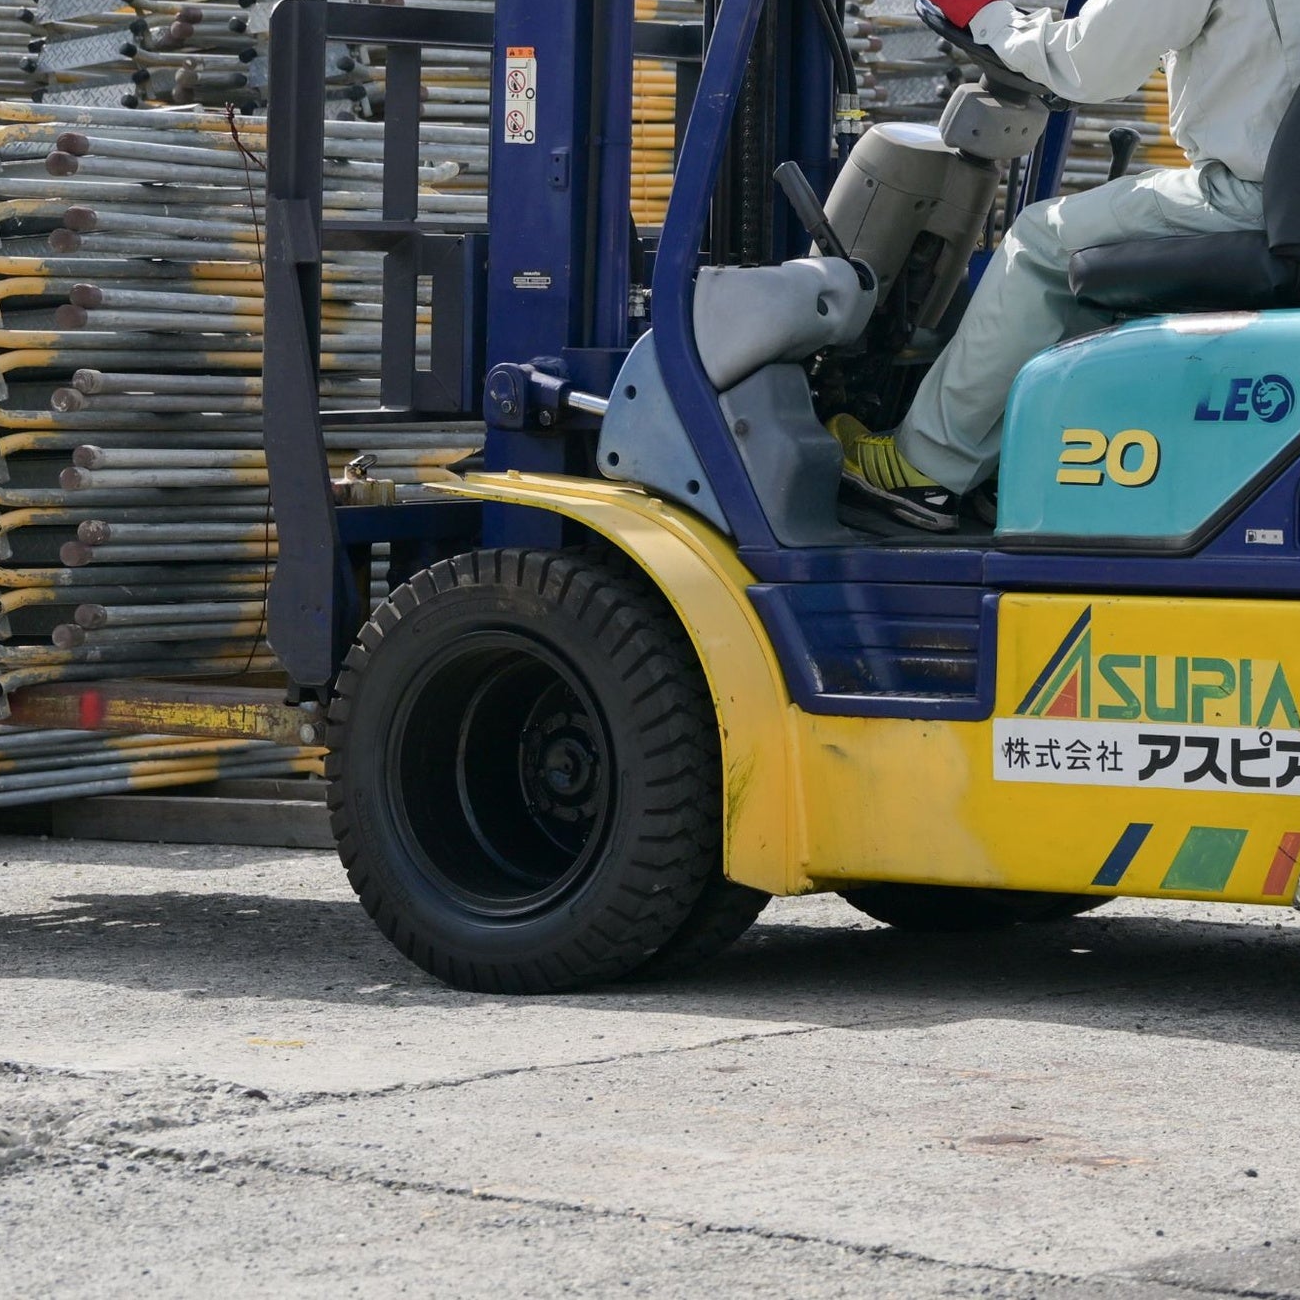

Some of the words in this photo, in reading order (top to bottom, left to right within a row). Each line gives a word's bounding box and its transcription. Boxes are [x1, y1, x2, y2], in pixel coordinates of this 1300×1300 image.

[1194, 374, 1295, 423] LEO
[1056, 429, 1161, 487] 20
[1005, 737, 1123, 772] 株式会社
